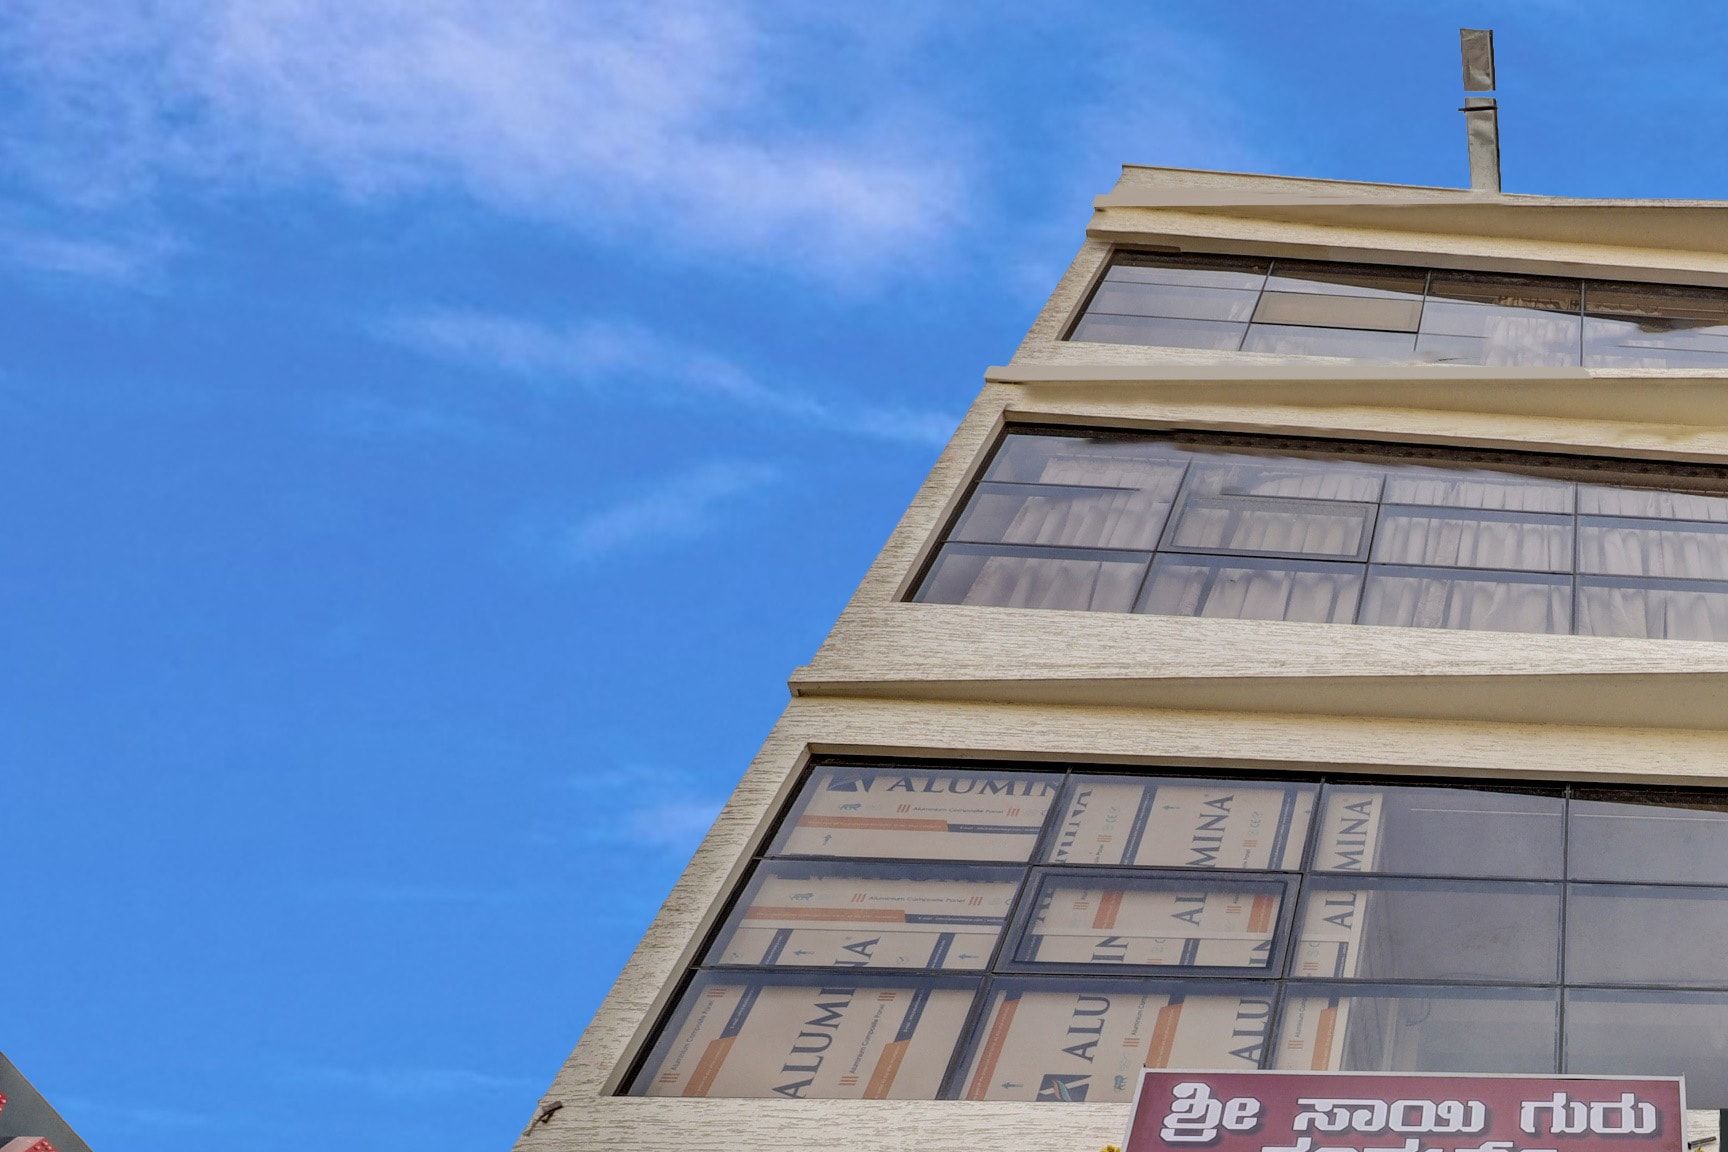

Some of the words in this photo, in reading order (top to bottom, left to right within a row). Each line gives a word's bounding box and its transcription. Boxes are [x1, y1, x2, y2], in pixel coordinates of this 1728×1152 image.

[1159, 1082, 1261, 1142] ಶ್ರೀ
[1292, 1096, 1485, 1135] ಸಾಯಿ
[1519, 1092, 1657, 1136] ಗುರು
